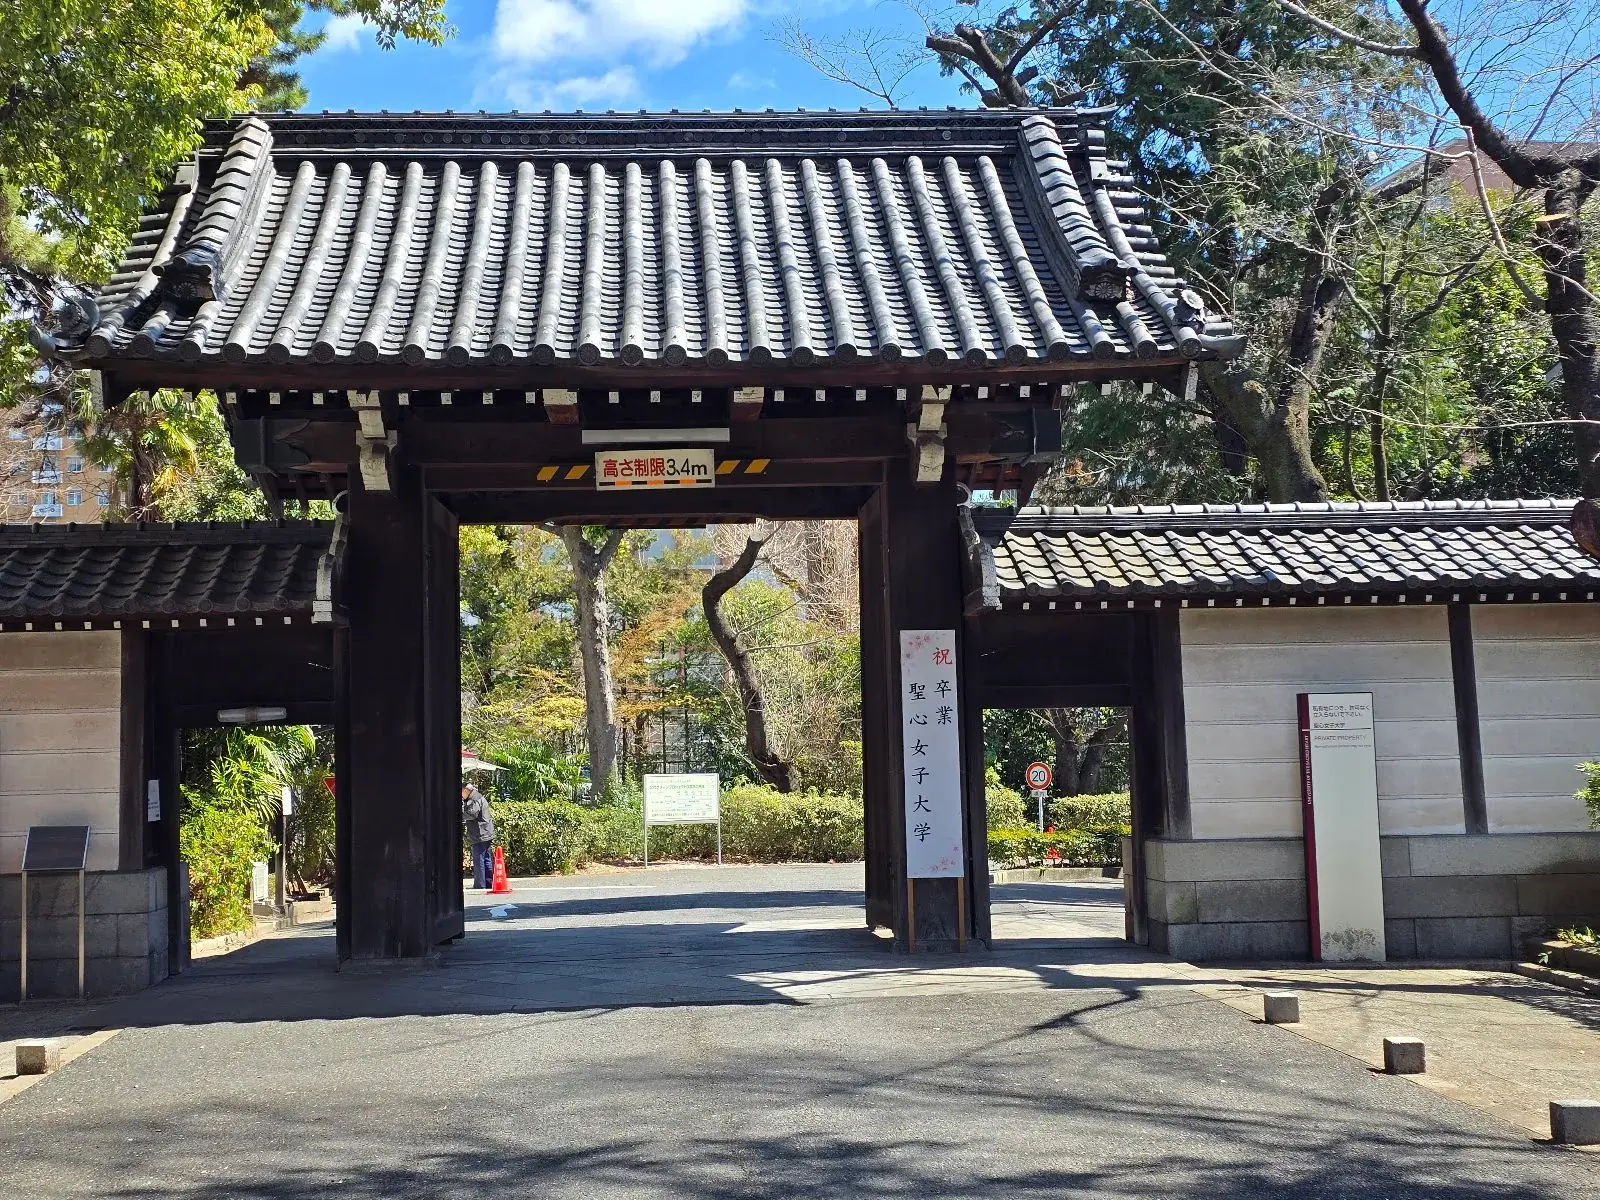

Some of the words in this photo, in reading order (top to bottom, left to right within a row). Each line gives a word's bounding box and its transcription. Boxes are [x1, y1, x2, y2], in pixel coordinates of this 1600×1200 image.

[908, 682, 932, 843] 聖心女子大学
[1031, 770, 1046, 782] 20
